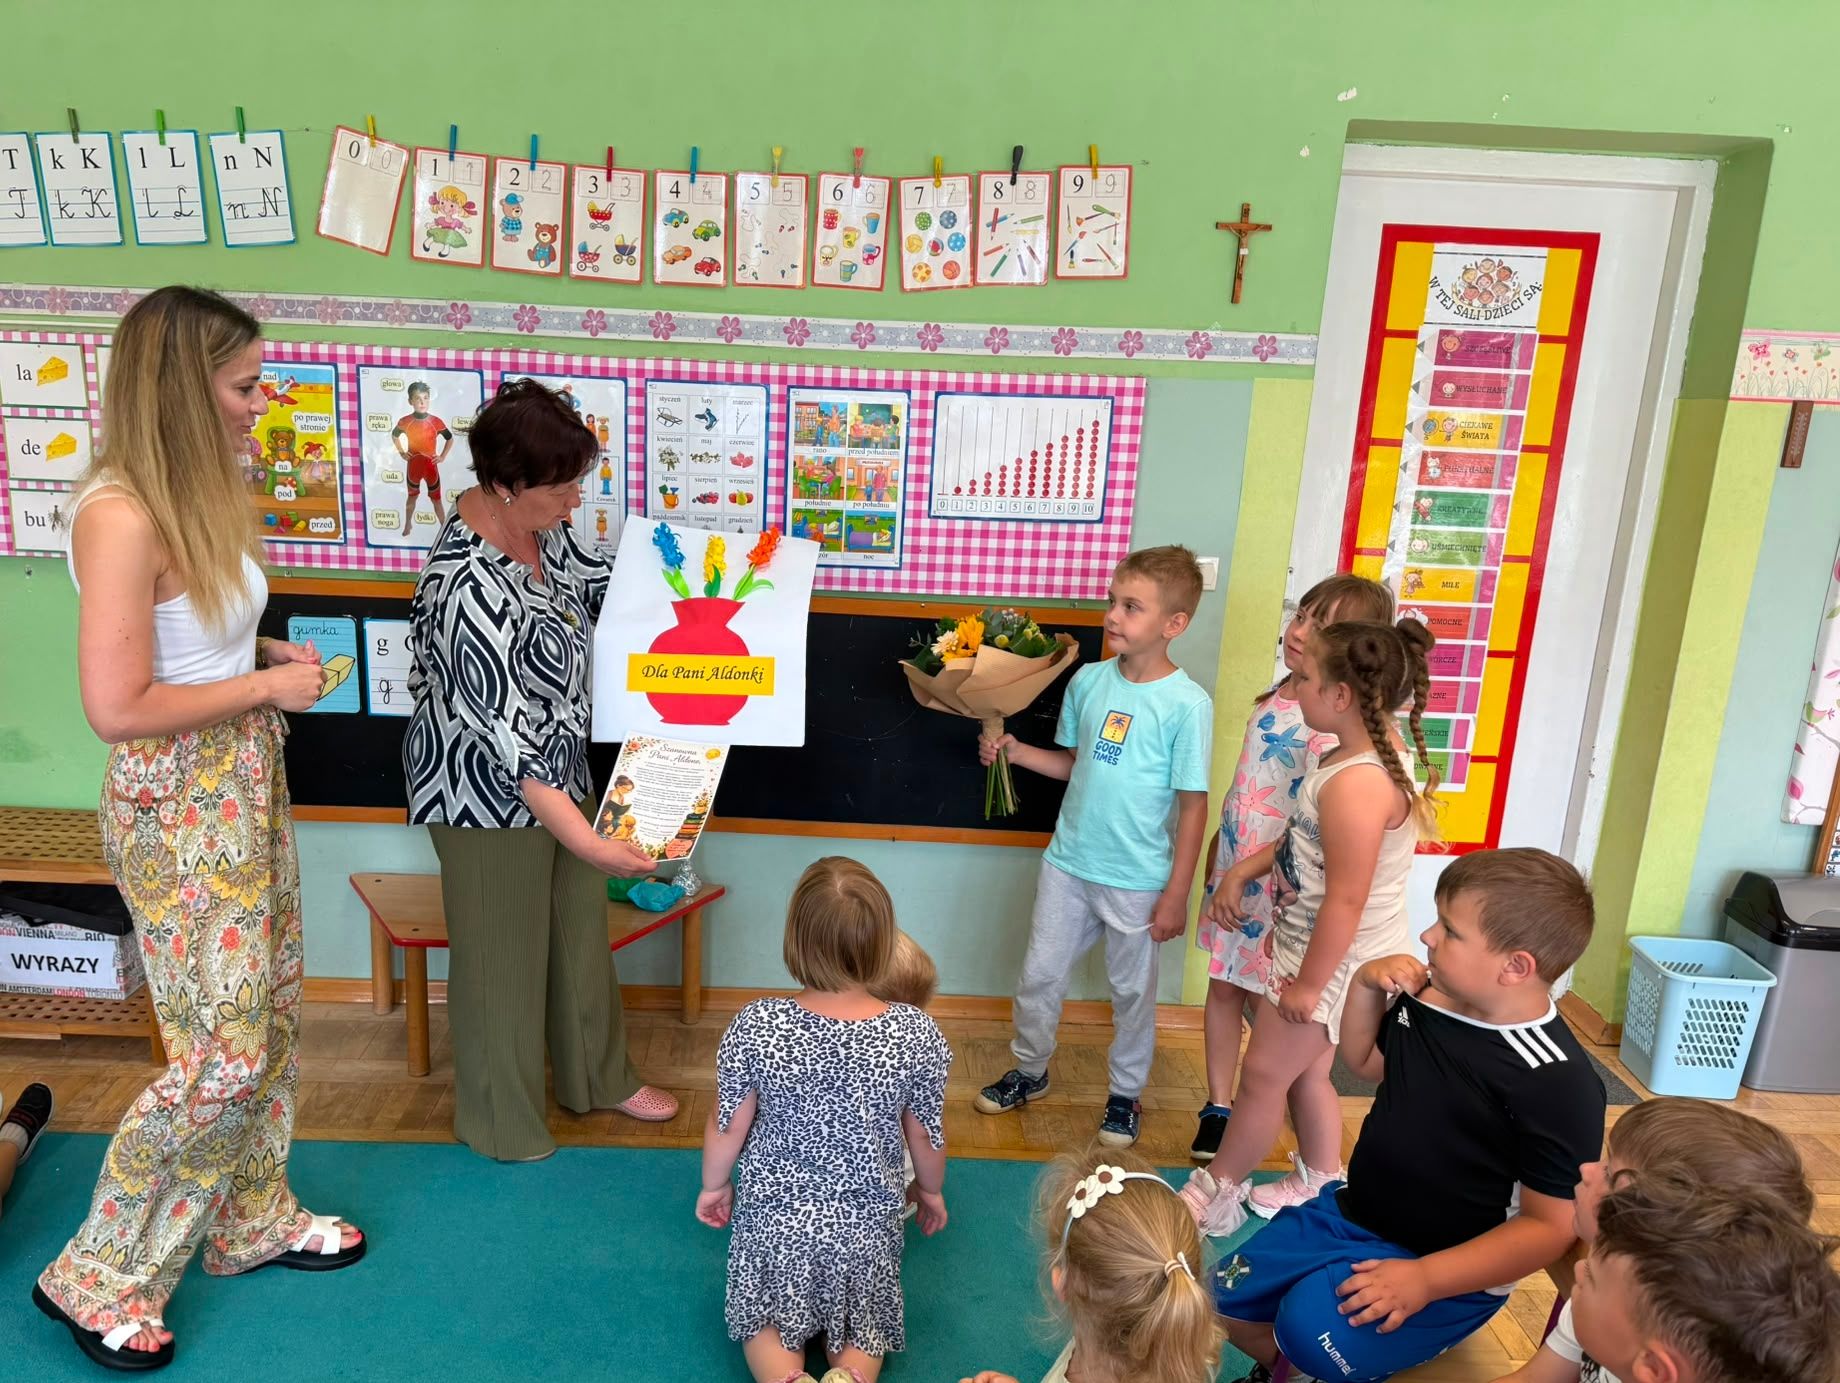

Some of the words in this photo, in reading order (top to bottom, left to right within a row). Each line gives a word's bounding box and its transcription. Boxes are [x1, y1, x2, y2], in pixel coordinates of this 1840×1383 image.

[2, 148, 19, 170] T
[49, 147, 66, 170] k
[80, 147, 102, 170] K
[168, 147, 186, 169] L
[222, 153, 239, 171] n
[252, 146, 274, 169] N
[348, 140, 361, 160] 0
[431, 158, 439, 178] 1
[509, 167, 522, 187] 2
[541, 168, 553, 192] 2
[587, 175, 600, 194] 3
[619, 176, 632, 198] 3
[1072, 174, 1085, 195] 9
[1104, 173, 1117, 195] 9
[668, 180, 682, 199] 4
[702, 180, 714, 201] 4
[749, 182, 761, 201] 5
[782, 183, 794, 202] 5
[831, 181, 845, 202] 6
[864, 182, 876, 204] 6
[912, 185, 925, 206] 7
[946, 185, 960, 206] 7
[992, 180, 1005, 201] 8
[1023, 181, 1037, 201] 8
[55, 188, 76, 220] k
[79, 185, 112, 220] K
[173, 184, 195, 221] L
[226, 201, 250, 220] n
[257, 186, 283, 219] N
[1429, 276, 1441, 290] W
[1435, 288, 1454, 311] TEJ
[1453, 304, 1481, 321] SALI
[1483, 297, 1525, 322] DZIECI
[16, 363, 33, 382] la
[262, 372, 278, 382] nad
[294, 414, 305, 424] po
[305, 414, 332, 426] prawej
[368, 414, 389, 423] prawa
[1459, 420, 1494, 430] CIEKAWE
[300, 424, 327, 433] stronie
[1461, 429, 1490, 440] ŚWIATA
[21, 439, 42, 456] de
[848, 448, 866, 457] przed
[278, 463, 288, 472] na
[386, 473, 399, 481] uda
[277, 489, 293, 500] pod
[375, 512, 396, 520] prawa
[955, 501, 960, 509] 1
[983, 502, 990, 510] 3
[997, 502, 1004, 510] 4
[1026, 503, 1034, 511] 6
[1041, 503, 1048, 511] 7
[1056, 504, 1063, 512] 8
[1071, 504, 1077, 512] 9
[1084, 504, 1094, 512] 10
[24, 510, 46, 528] bu
[311, 520, 334, 532] przed
[293, 621, 336, 640] gumka
[376, 638, 389, 656] g
[641, 664, 669, 679] Dla
[671, 666, 706, 680] Pani
[705, 667, 764, 685] Aldonki
[378, 679, 393, 705] g
[648, 749, 670, 760] Pani
[660, 743, 698, 756] Szanowna
[1092, 750, 1119, 765] TIMES
[1095, 740, 1122, 756] GOOD
[15, 927, 56, 940] VIENNA
[85, 931, 105, 942] RIO
[11, 953, 99, 974] WYRAZY
[1317, 1331, 1357, 1377] hummel
